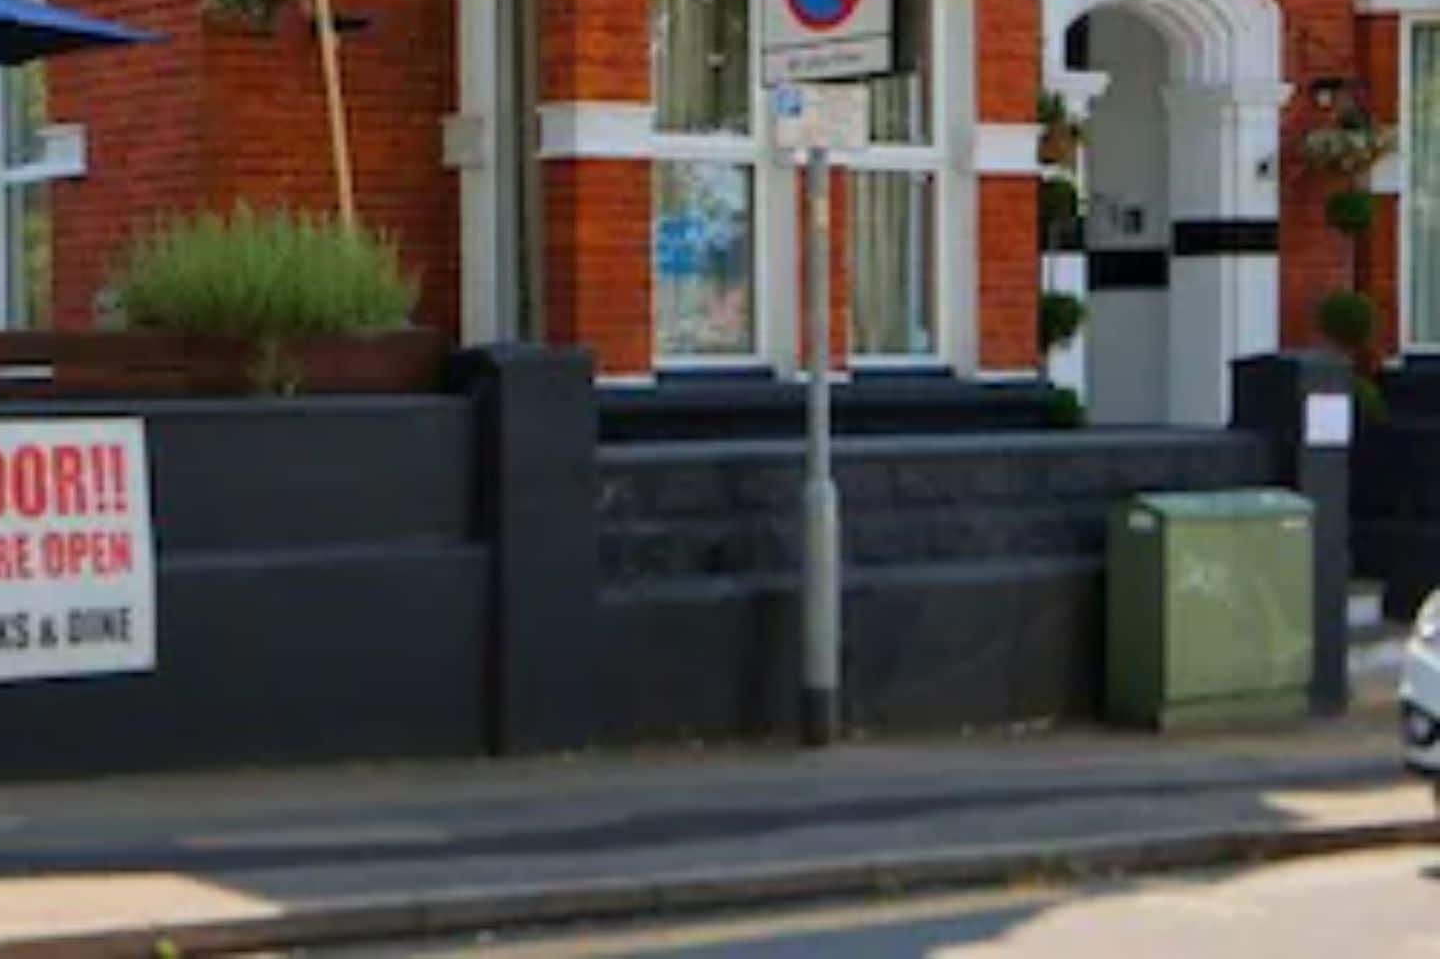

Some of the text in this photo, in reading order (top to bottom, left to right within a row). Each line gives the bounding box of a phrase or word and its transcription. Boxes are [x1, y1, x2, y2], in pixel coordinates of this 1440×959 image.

[42, 532, 134, 575] OPEN
[39, 616, 59, 647] &
[67, 606, 132, 645] DINE
